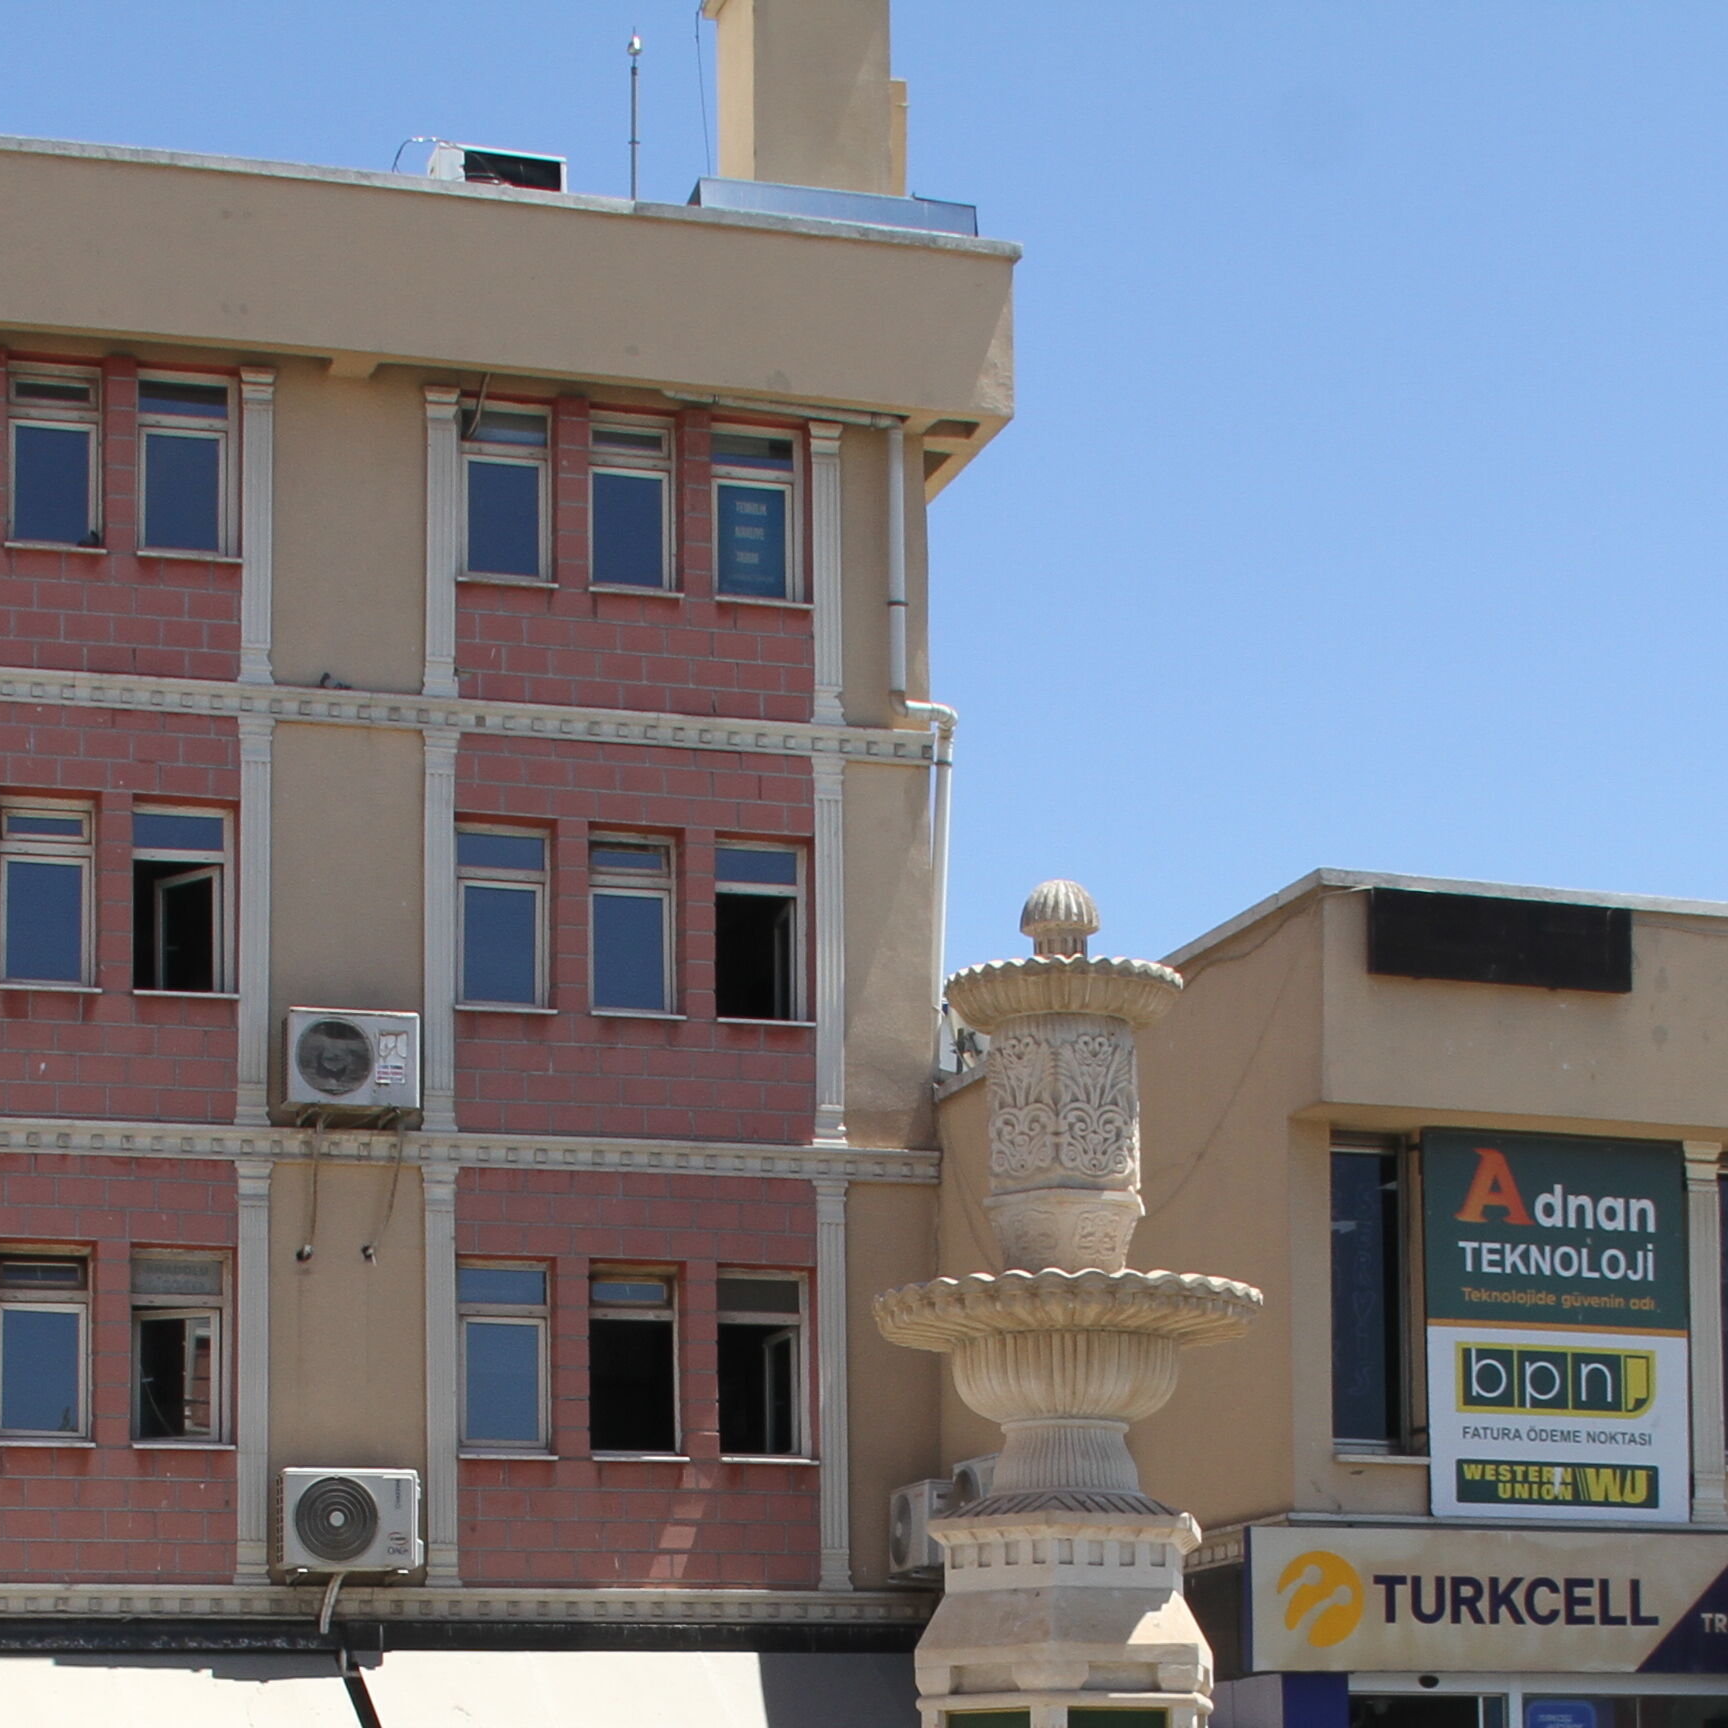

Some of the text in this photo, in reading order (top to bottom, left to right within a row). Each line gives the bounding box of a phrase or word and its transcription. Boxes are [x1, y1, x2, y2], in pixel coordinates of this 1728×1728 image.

[1454, 1147, 1657, 1234] Adnan
[1458, 1240, 1655, 1281] TEKNOLOJİ
[1462, 1286, 1656, 1309] Teknolojide güvenin adı
[1472, 1347, 1613, 1409] bpn
[1462, 1425, 1652, 1446] FATURA ÖDEME NOKTASI
[1463, 1463, 1572, 1483] WESTERN
[1497, 1482, 1573, 1500] UNION
[1373, 1575, 1660, 1627] TURKCELL
